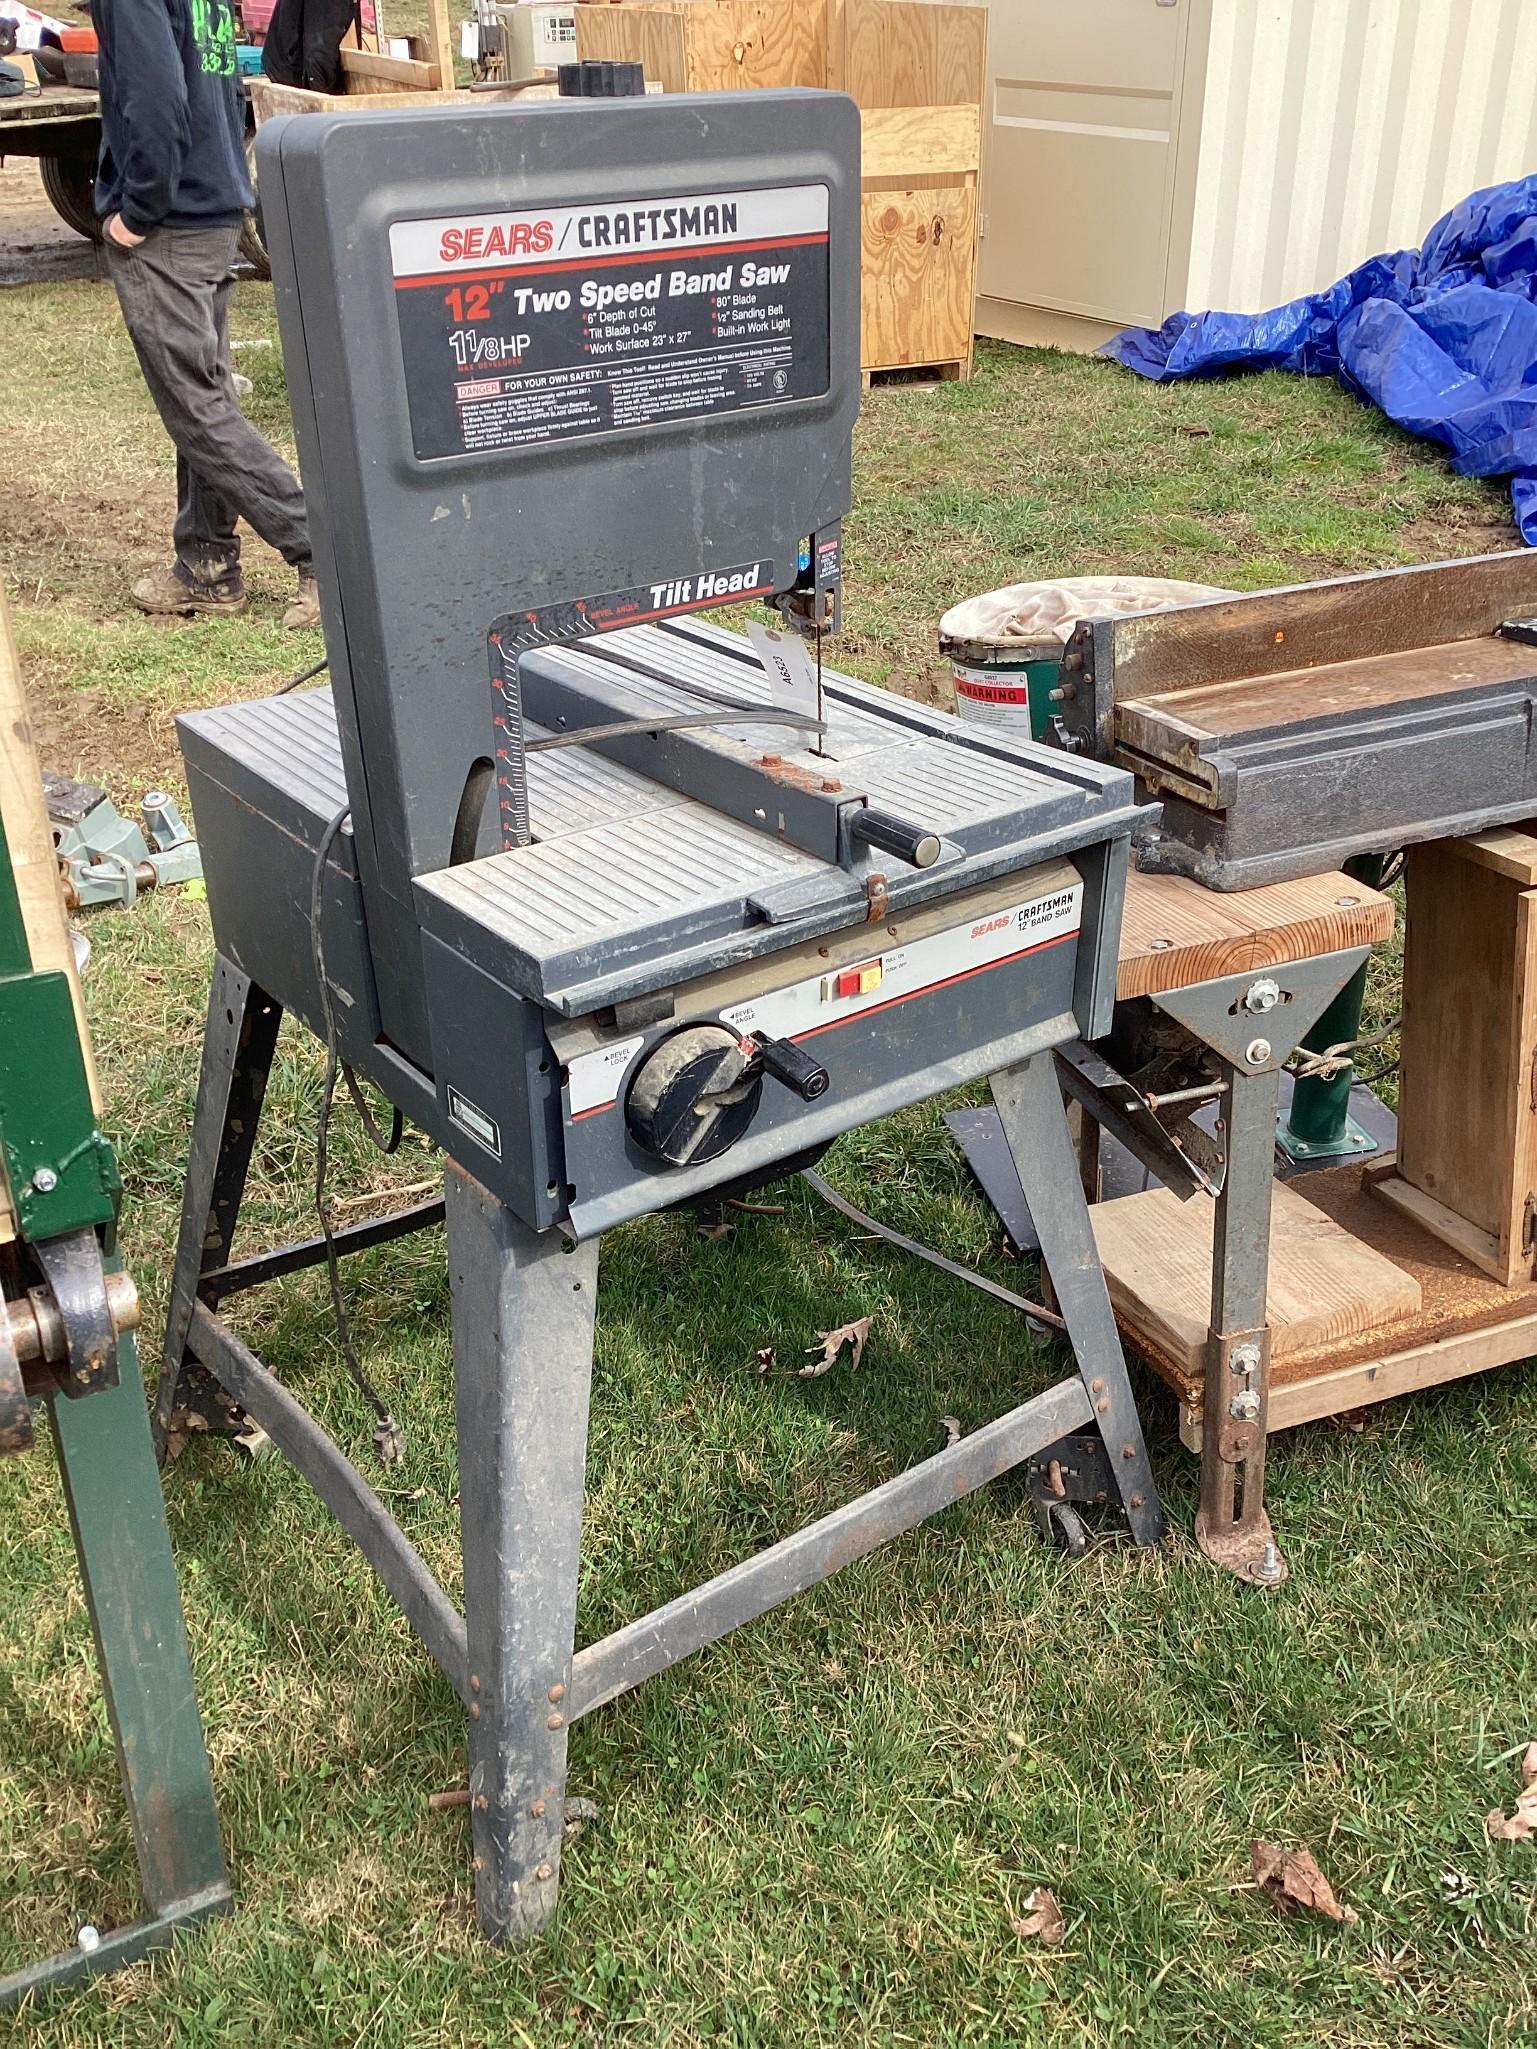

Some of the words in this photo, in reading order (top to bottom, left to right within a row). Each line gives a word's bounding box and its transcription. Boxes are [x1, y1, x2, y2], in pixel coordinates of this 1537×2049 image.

[439, 220, 553, 262] SEARS
[577, 203, 737, 248] CRAFTSMAN
[444, 281, 504, 322] 12"
[513, 287, 571, 315] Two
[579, 273, 662, 310] Speed
[668, 264, 733, 296] Band
[739, 262, 791, 287] Saw
[716, 295, 730, 307] 80"
[732, 292, 756, 305] Blade
[587, 312, 597, 324] 6"
[599, 309, 626, 323] Depth
[628, 307, 637, 318] of
[640, 305, 655, 317] Cut
[731, 307, 765, 320] Sanding
[767, 303, 783, 315] Belt
[588, 327, 602, 339] Tilt
[605, 324, 630, 337] Blade
[717, 324, 745, 337] Built-in
[747, 320, 768, 333] Work
[771, 317, 790, 331] Light
[589, 341, 613, 354] Work
[615, 337, 649, 351] Surface
[652, 333, 666, 346] 23"
[668, 335, 674, 343] x
[676, 330, 691, 342] 27"
[671, 357, 697, 367] Understand
[698, 355, 717, 363] Owner's
[717, 352, 734, 360] Manual
[505, 381, 521, 391] FOR
[523, 377, 548, 388] YOUR
[550, 374, 568, 384] OWN
[570, 369, 602, 382] SAFETY:
[460, 383, 497, 396] DANGER
[650, 581, 691, 608] Tilt
[696, 564, 760, 600] Head
[772, 655, 794, 686] A6523
[966, 684, 1017, 701] WARNING
[970, 915, 1010, 939] SEARS
[1018, 892, 1074, 922] CRAFTSMAN
[1031, 913, 1053, 928] BAND
[1055, 905, 1073, 919] SAW
[735, 1007, 754, 1018] BEVEL
[735, 1013, 756, 1025] ANGLE
[610, 1048, 631, 1059] BEVEL
[610, 1055, 629, 1066] LOCK
